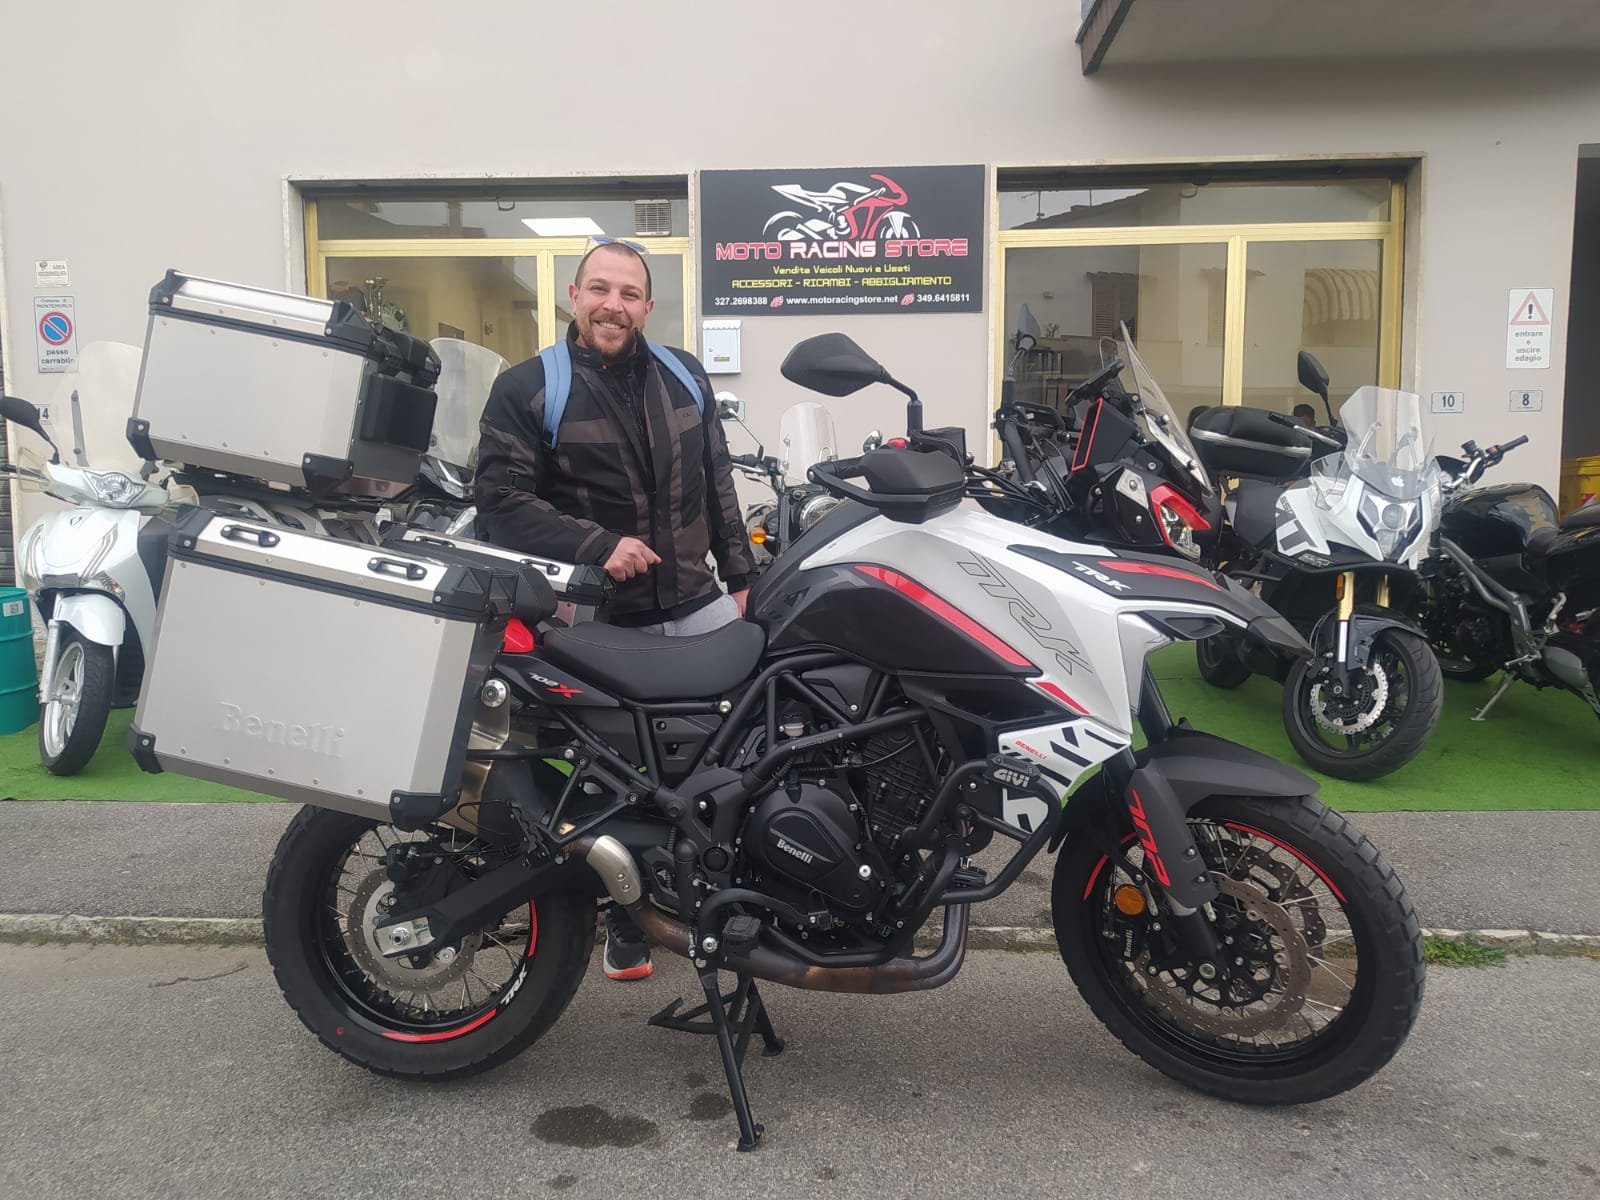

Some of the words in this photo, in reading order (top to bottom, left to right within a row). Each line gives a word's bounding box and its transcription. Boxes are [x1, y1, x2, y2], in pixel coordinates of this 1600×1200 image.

[715, 242, 782, 260] MOTO
[790, 240, 876, 259] RACING
[884, 238, 968, 257] STORE
[773, 265, 810, 275] Vendita
[813, 265, 843, 274] Veicoli
[845, 264, 873, 273] Nuovi
[883, 263, 911, 273] Usati
[732, 279, 793, 289] ACCESSORI
[803, 278, 852, 288] RICAMBI
[862, 276, 952, 286] ABBIGLIAMENTO
[714, 297, 768, 306] 327.2698388
[786, 295, 898, 306] www.motoracingstore.net
[916, 293, 970, 303] 349.6415811
[1515, 330, 1544, 338] entrare
[1516, 346, 1541, 354] uscire
[1514, 354, 1542, 363] adagio
[1442, 394, 1456, 408] 10
[1522, 393, 1530, 406] 8
[1072, 561, 1133, 593] TRK
[216, 698, 346, 759] Benelli
[1015, 740, 1048, 760] BENELLI
[993, 768, 1031, 788] GIVI
[776, 838, 814, 864] Benelli
